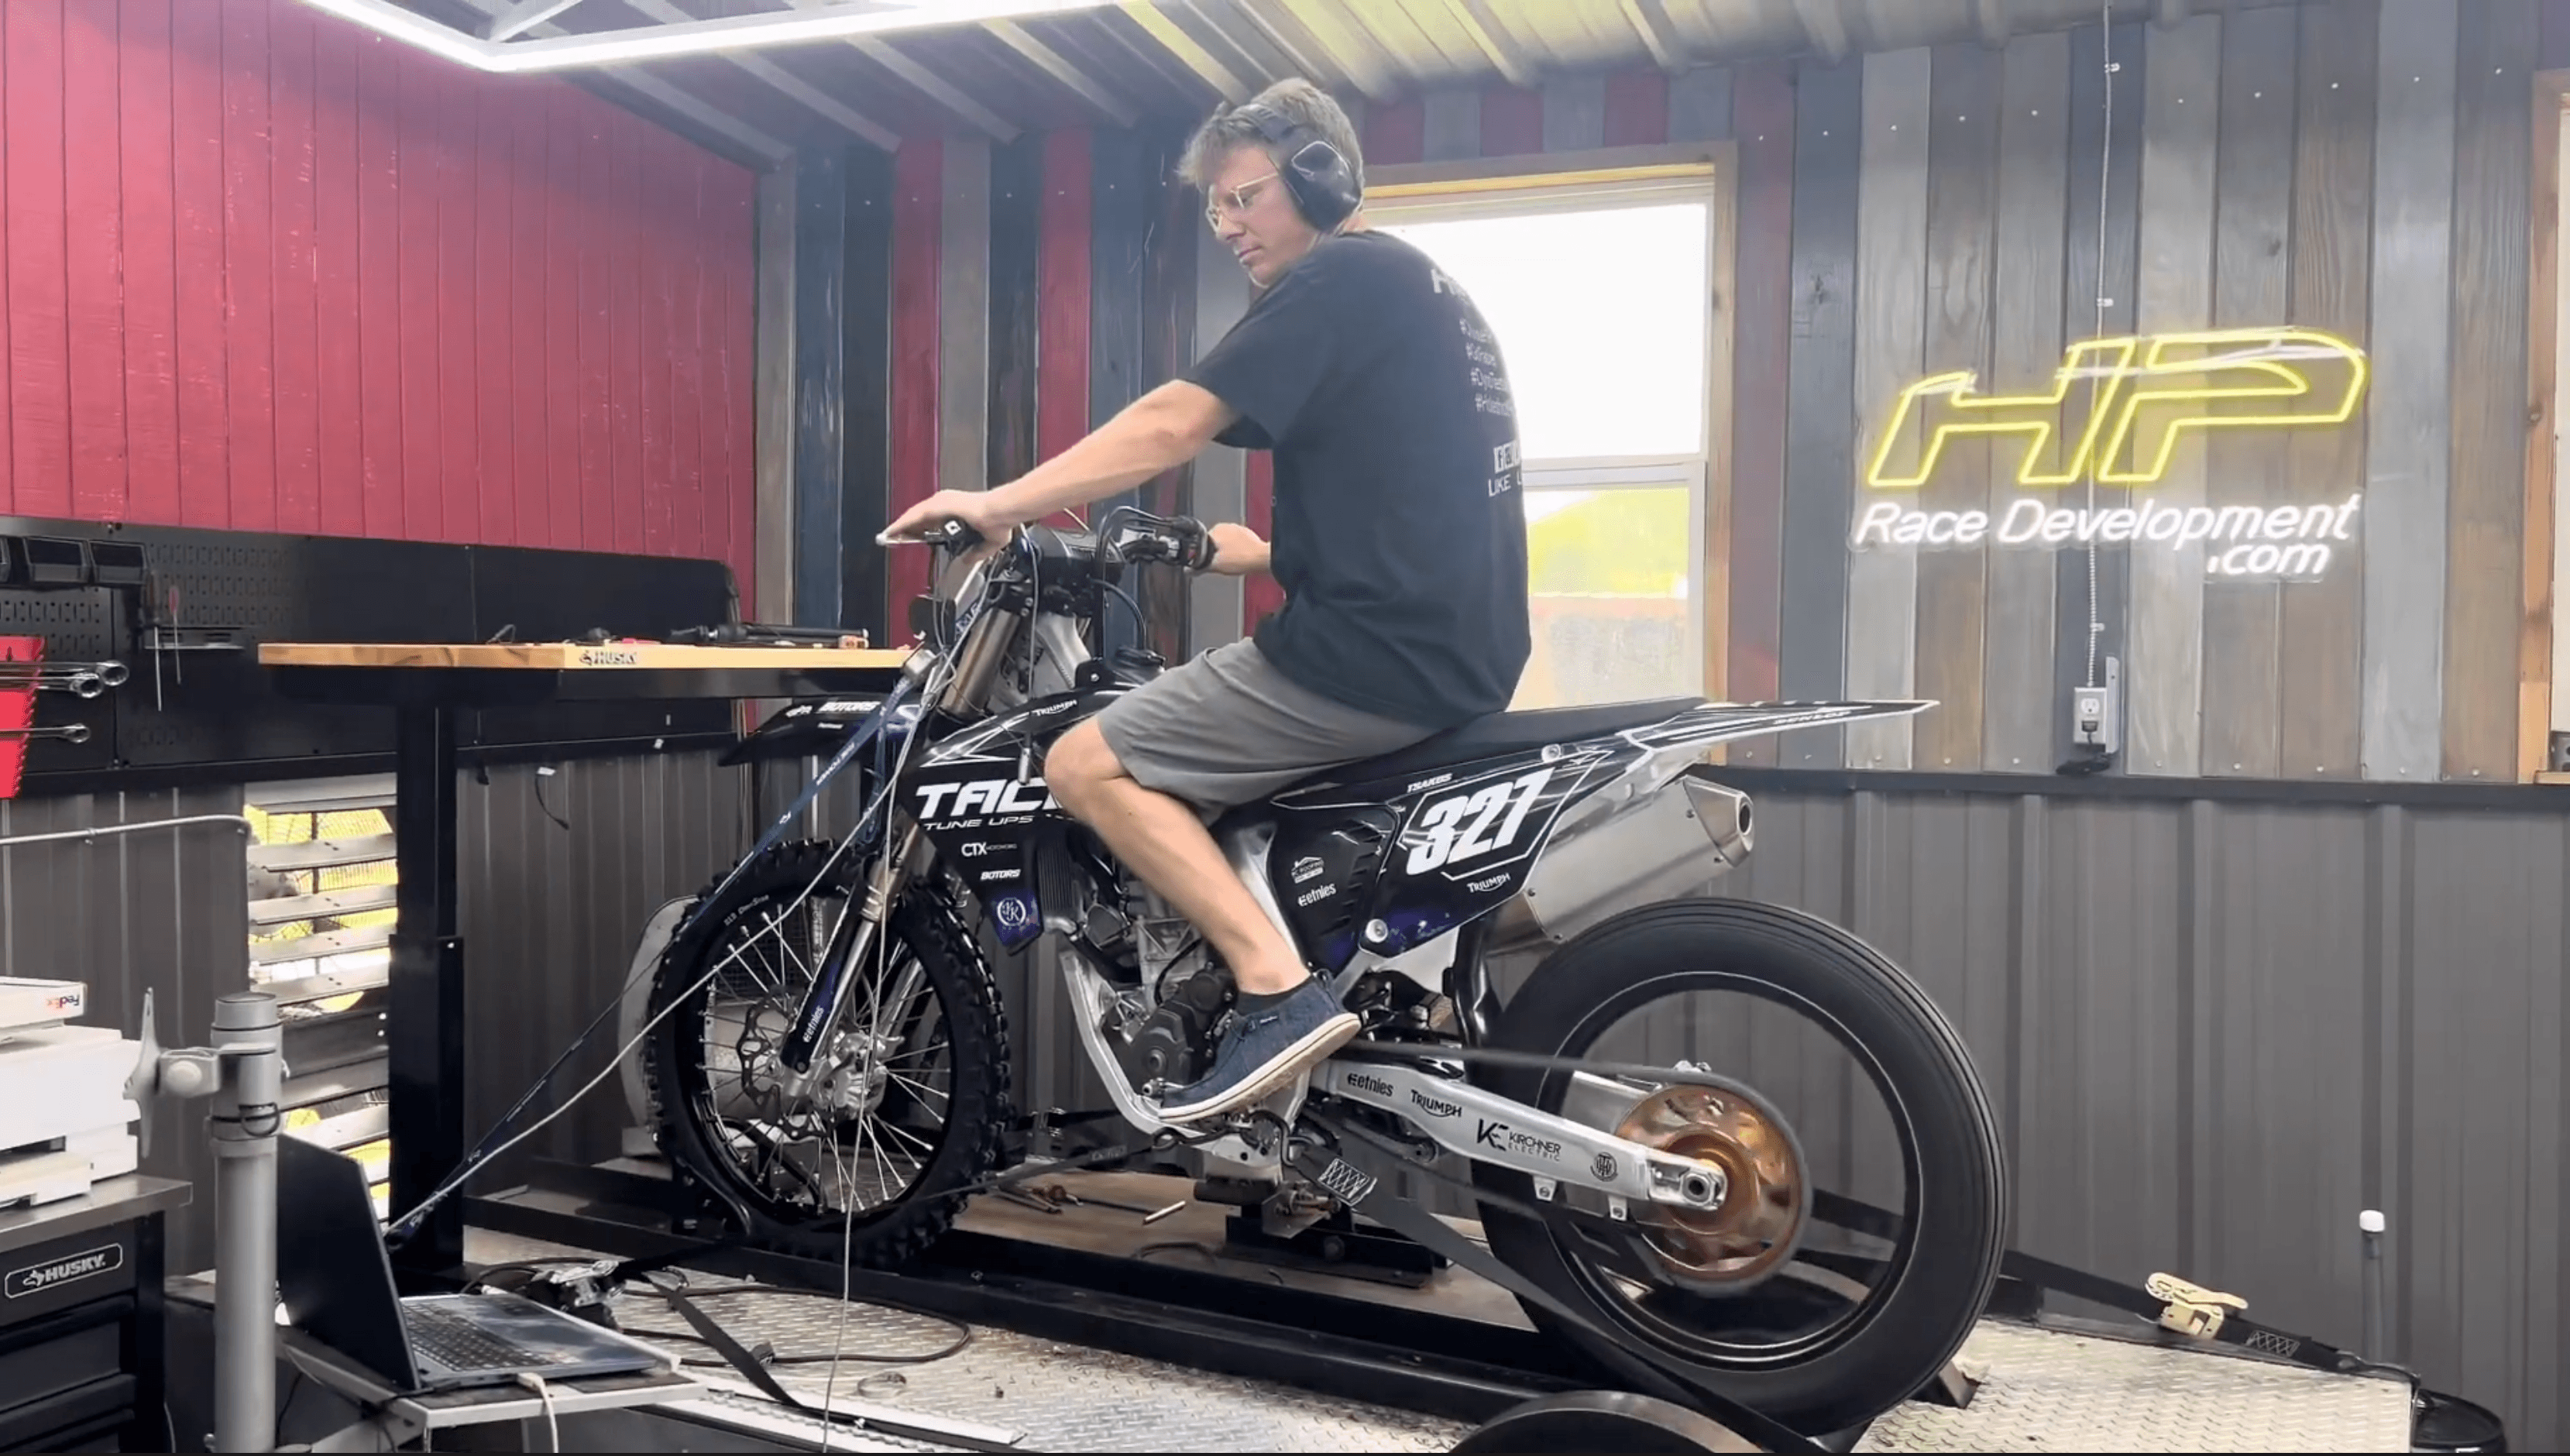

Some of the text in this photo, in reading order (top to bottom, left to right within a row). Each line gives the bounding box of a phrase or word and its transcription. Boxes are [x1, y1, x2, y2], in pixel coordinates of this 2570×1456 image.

[1867, 325, 2365, 486] HP
[1854, 496, 2362, 551] Race Development
[2206, 543, 2329, 576] .com
[1032, 699, 1077, 716] TRIUMPH
[924, 816, 1036, 831] TUNE UPS
[1406, 767, 1555, 876] 327
[960, 842, 988, 857] CTX
[1466, 872, 1511, 893] TRIUMPH
[1410, 1089, 1463, 1118] TRIUMPH
[1508, 1142, 1561, 1162] ELECTRIC
[1510, 1131, 1562, 1155] KIRCHNER
